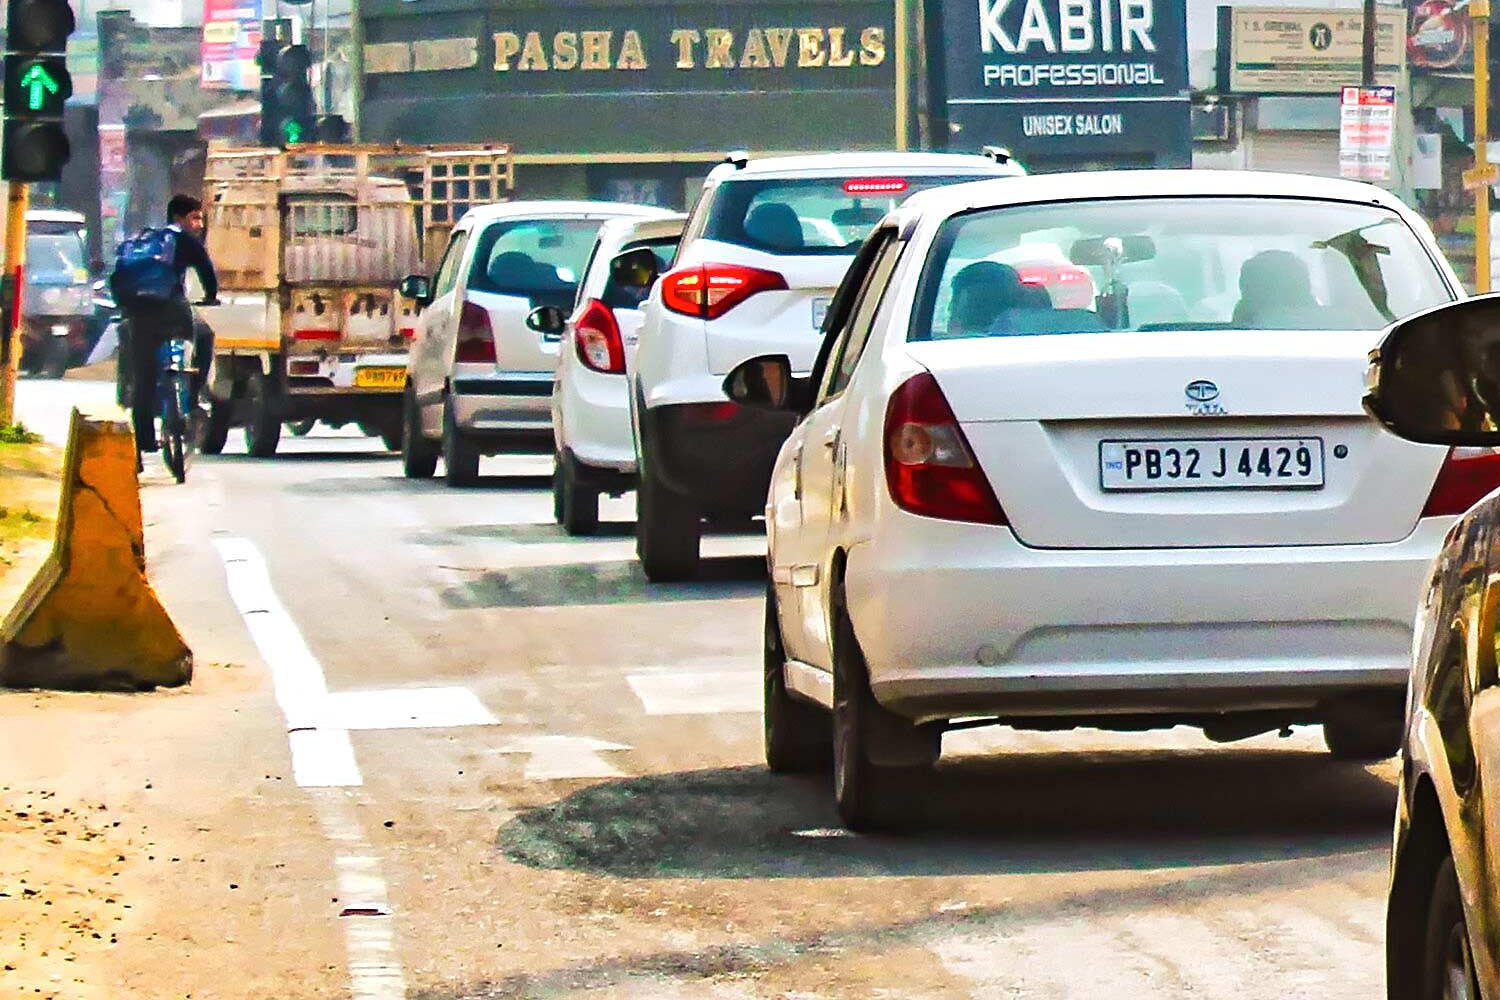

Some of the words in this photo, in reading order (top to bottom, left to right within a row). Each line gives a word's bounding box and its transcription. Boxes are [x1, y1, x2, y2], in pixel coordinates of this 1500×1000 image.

[493, 29, 648, 71] PASHA
[670, 27, 886, 69] TRAVELS
[1023, 115, 1072, 136] UNISEX
[1075, 113, 1122, 135] SALON
[1124, 448, 1201, 479] PB32
[1212, 447, 1227, 478] J
[1237, 447, 1312, 477] 4429
